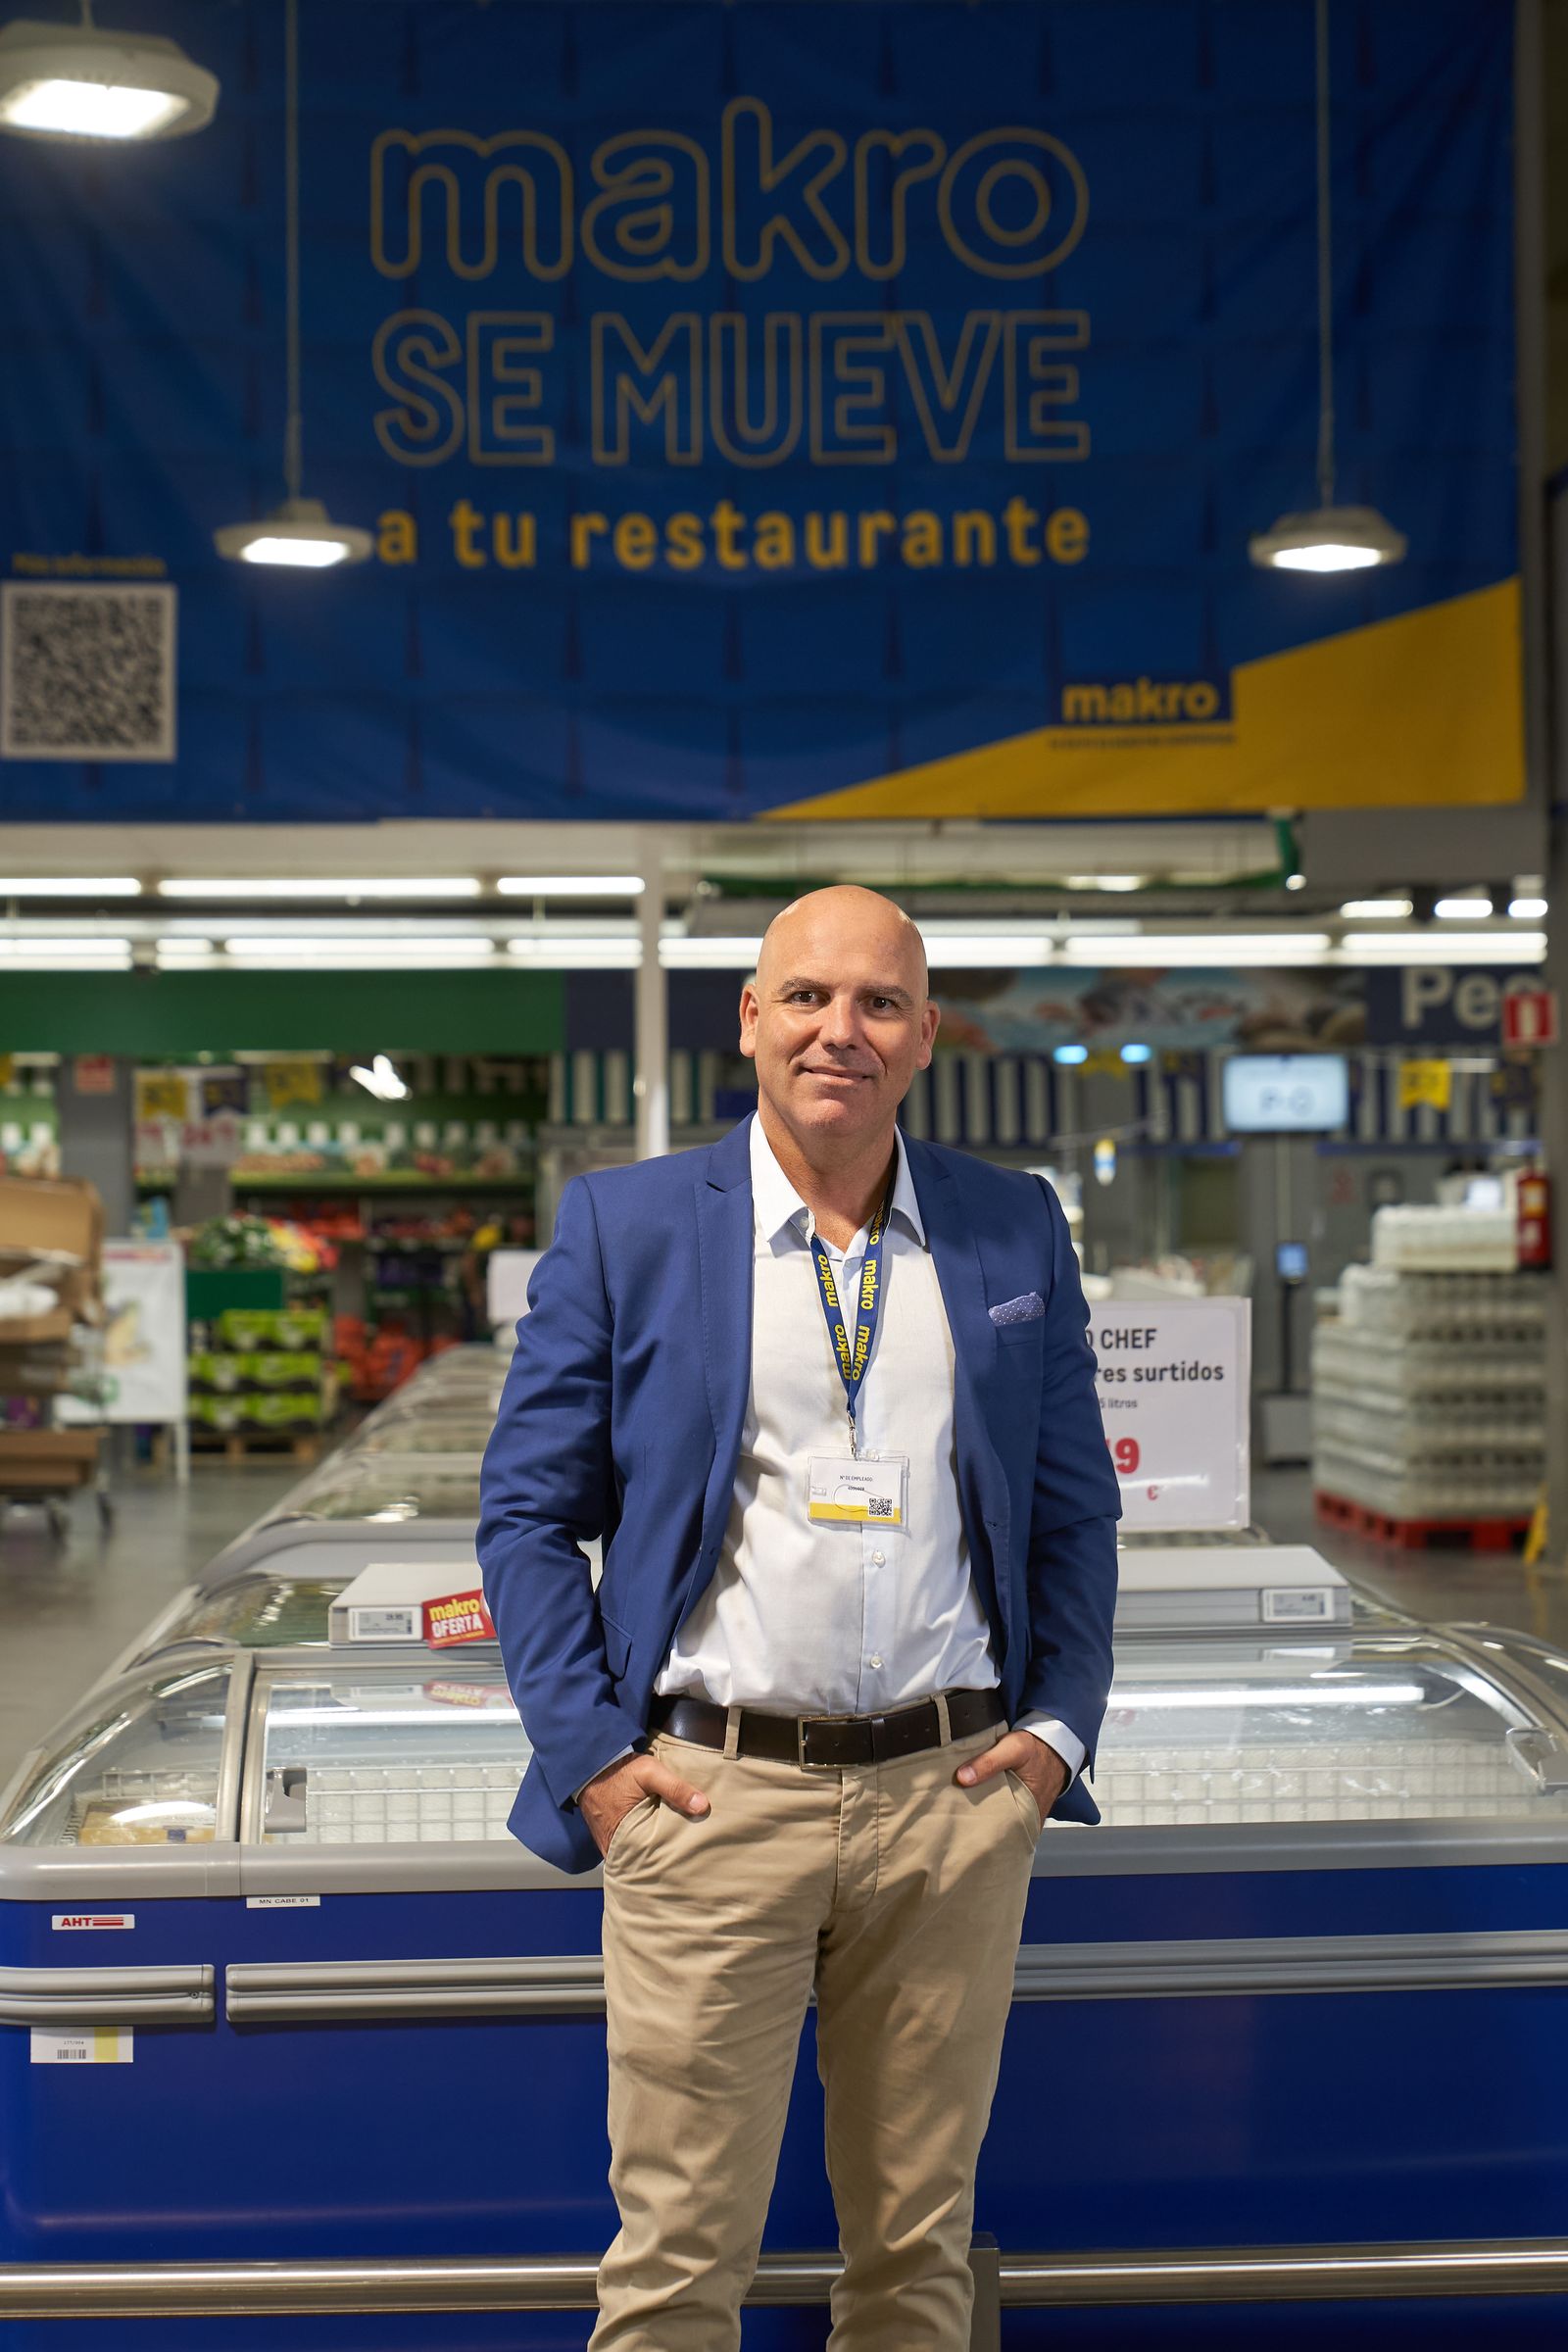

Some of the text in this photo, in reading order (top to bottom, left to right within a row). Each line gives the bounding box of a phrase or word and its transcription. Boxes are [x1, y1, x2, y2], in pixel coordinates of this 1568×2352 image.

[369, 96, 1090, 282] makro
[372, 310, 1090, 467] SE MUEVE
[378, 497, 1090, 568] a tu restaurante
[1062, 676, 1219, 723] makro
[817, 1253, 840, 1307] makro
[860, 1259, 879, 1310] makro
[852, 1325, 871, 1381] makro
[1101, 1328, 1157, 1349] CHEF
[1095, 1361, 1224, 1383] res surtidos
[1107, 1398, 1138, 1409] litros
[429, 1598, 480, 1622] makro
[431, 1614, 483, 1638] OFERTA
[61, 1917, 92, 1928] AHT
